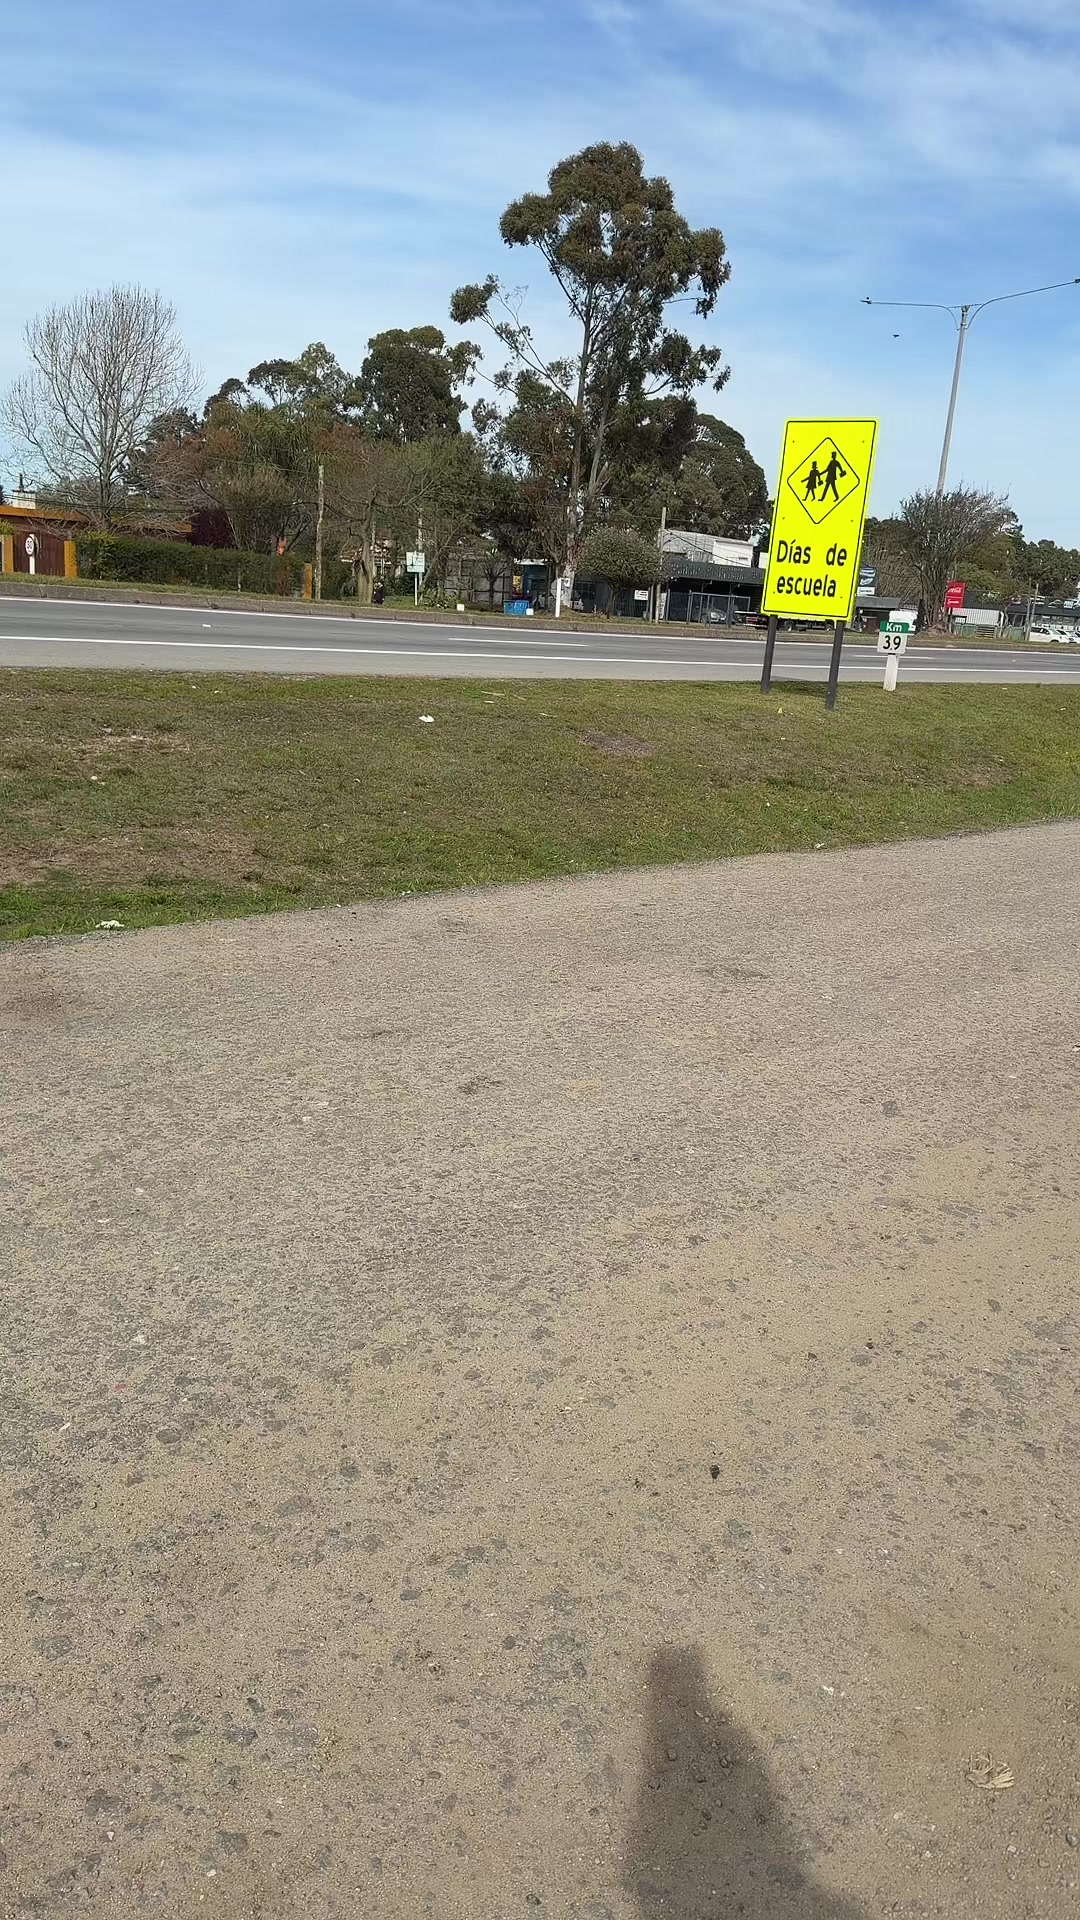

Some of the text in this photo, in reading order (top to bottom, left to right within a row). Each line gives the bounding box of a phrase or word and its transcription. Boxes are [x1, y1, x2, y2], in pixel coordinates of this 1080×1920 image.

[776, 539, 847, 567] Días de
[776, 574, 837, 598] escuela
[886, 623, 902, 632] Km
